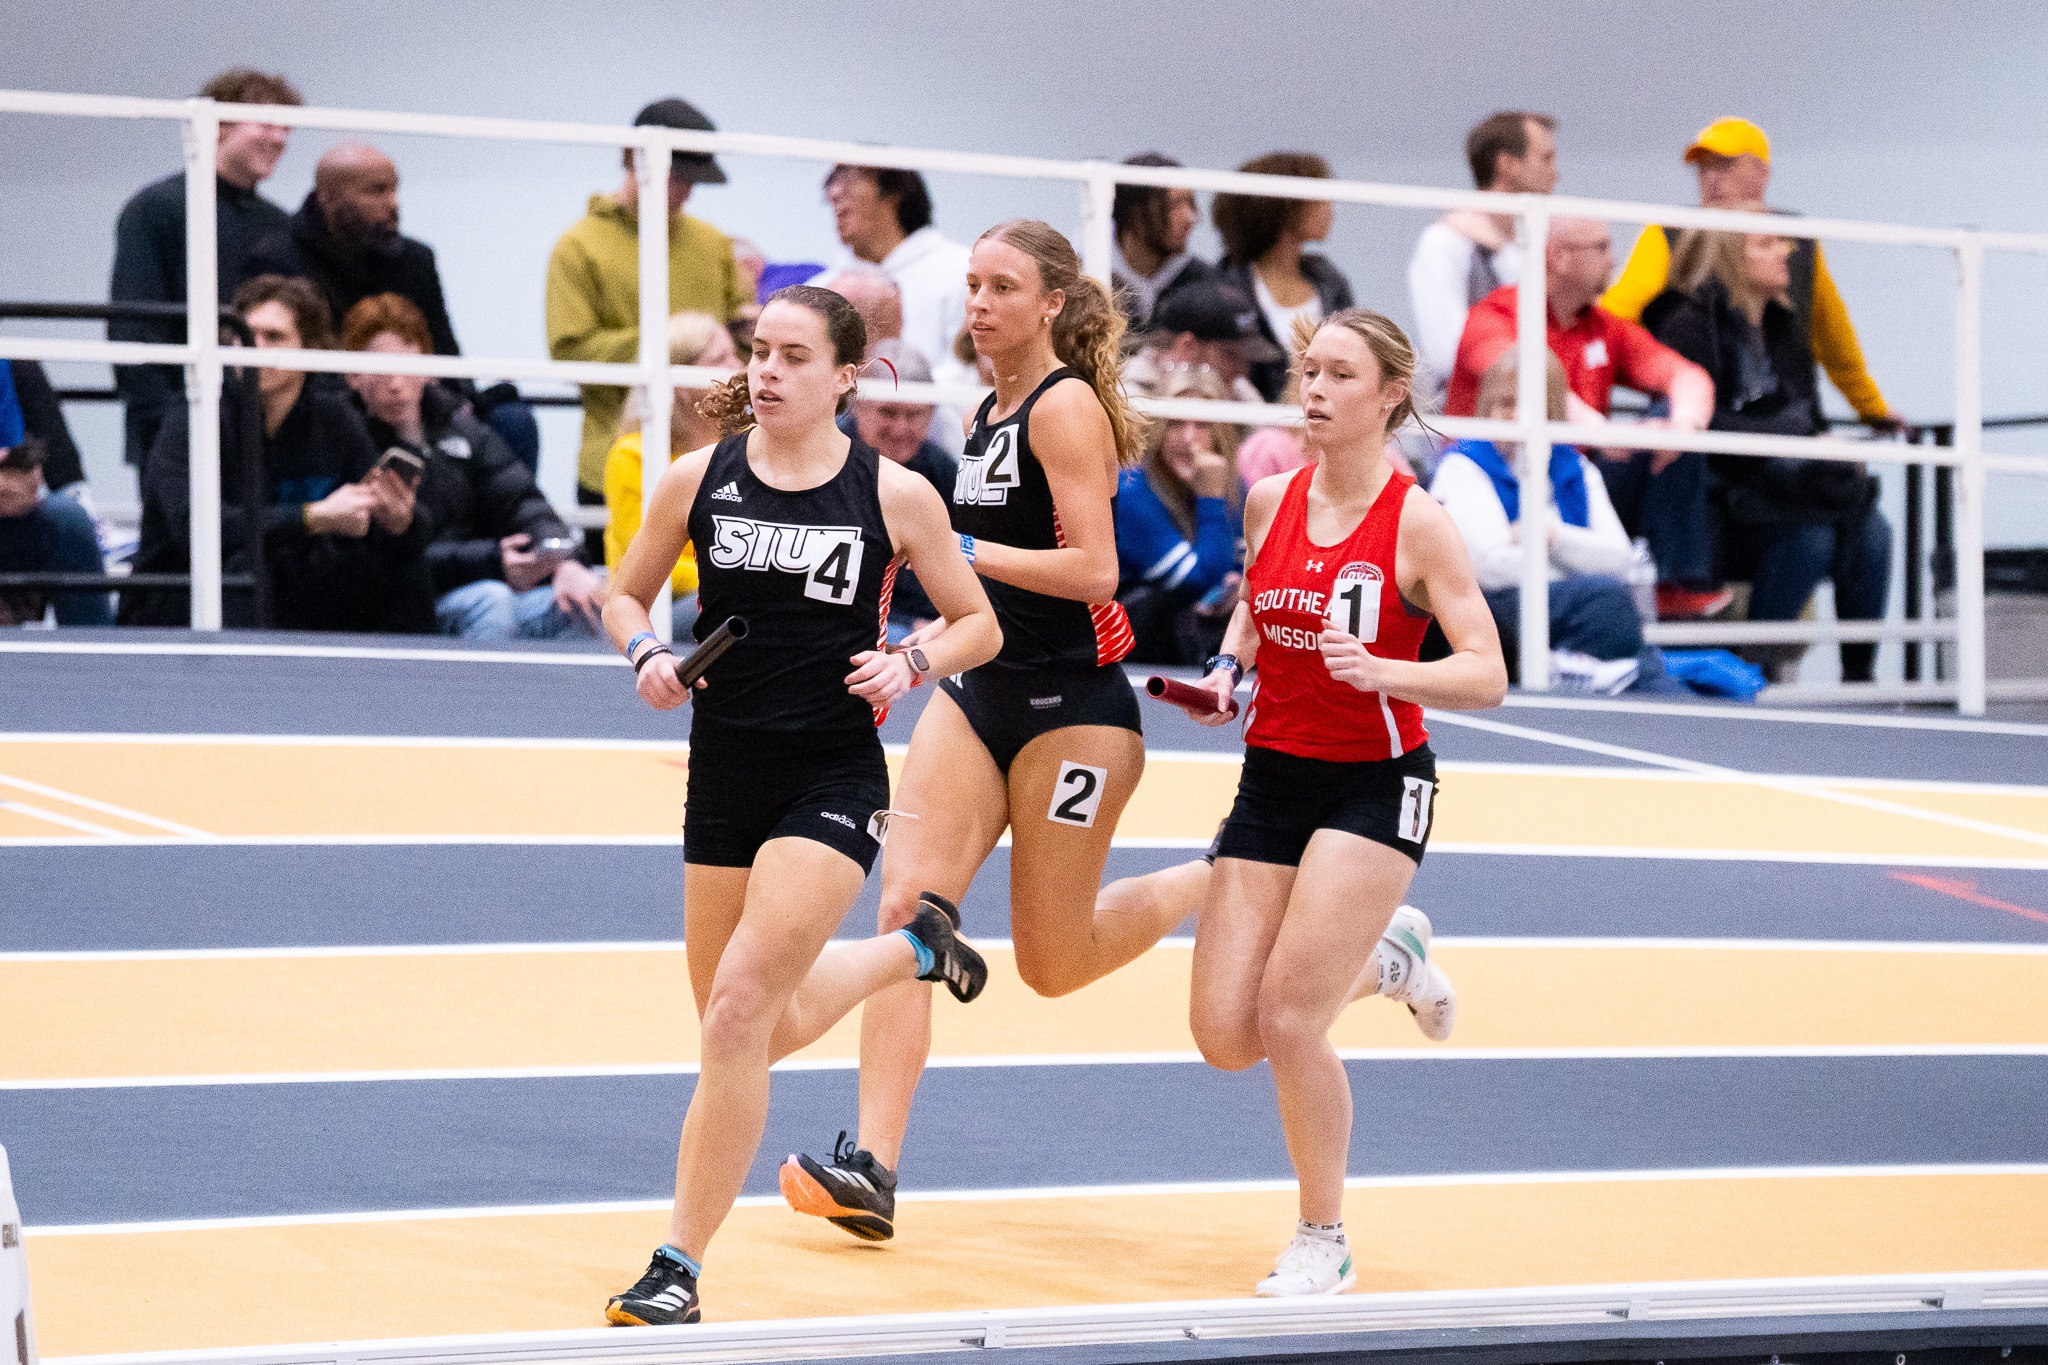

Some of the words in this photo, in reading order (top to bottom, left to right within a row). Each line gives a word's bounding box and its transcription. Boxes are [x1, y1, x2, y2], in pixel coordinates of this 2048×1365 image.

[985, 430, 1012, 484] 2
[711, 491, 743, 503] adidas
[709, 515, 862, 574] SIU
[813, 541, 852, 599] 4
[1263, 622, 1322, 651] MISSO
[1340, 584, 1362, 639] 1
[821, 811, 856, 829] adidas
[1054, 768, 1097, 823] 2
[1409, 783, 1423, 838] 1
